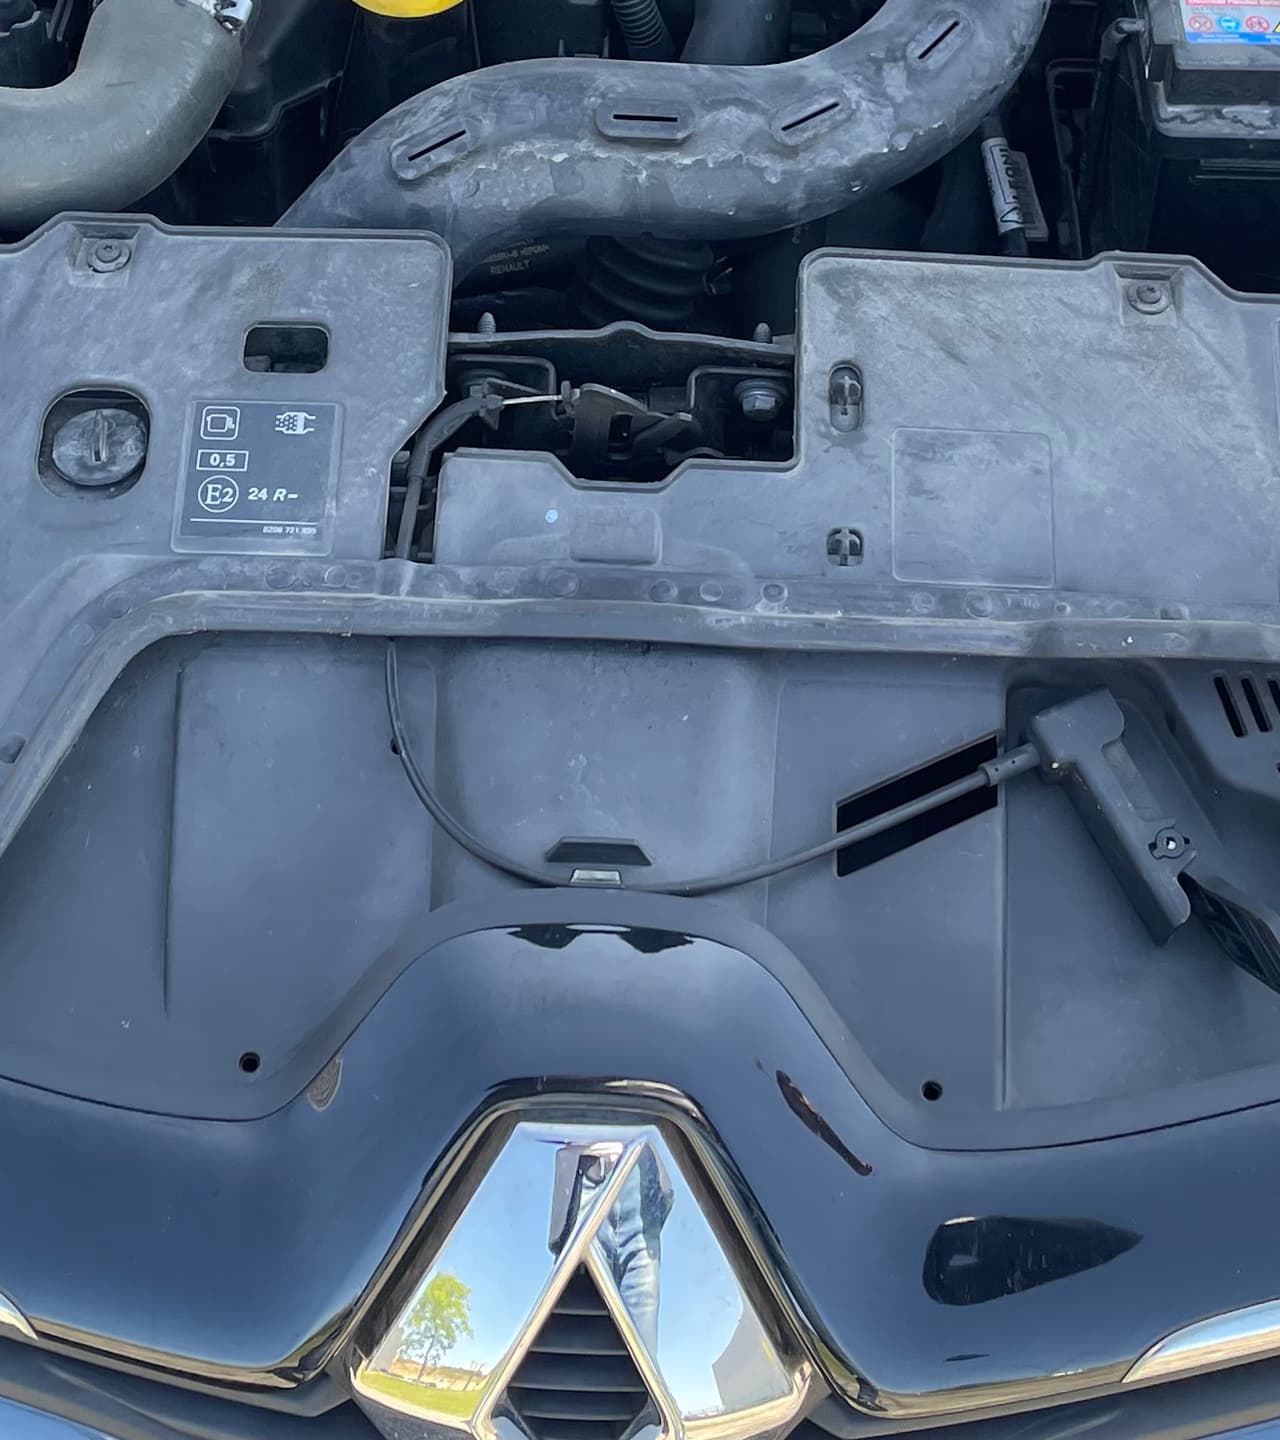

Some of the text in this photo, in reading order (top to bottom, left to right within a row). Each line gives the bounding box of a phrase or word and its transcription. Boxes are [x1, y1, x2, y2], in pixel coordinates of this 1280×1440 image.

[209, 453, 236, 468] 0,5
[204, 483, 234, 505] E2
[247, 487, 268, 501] 24
